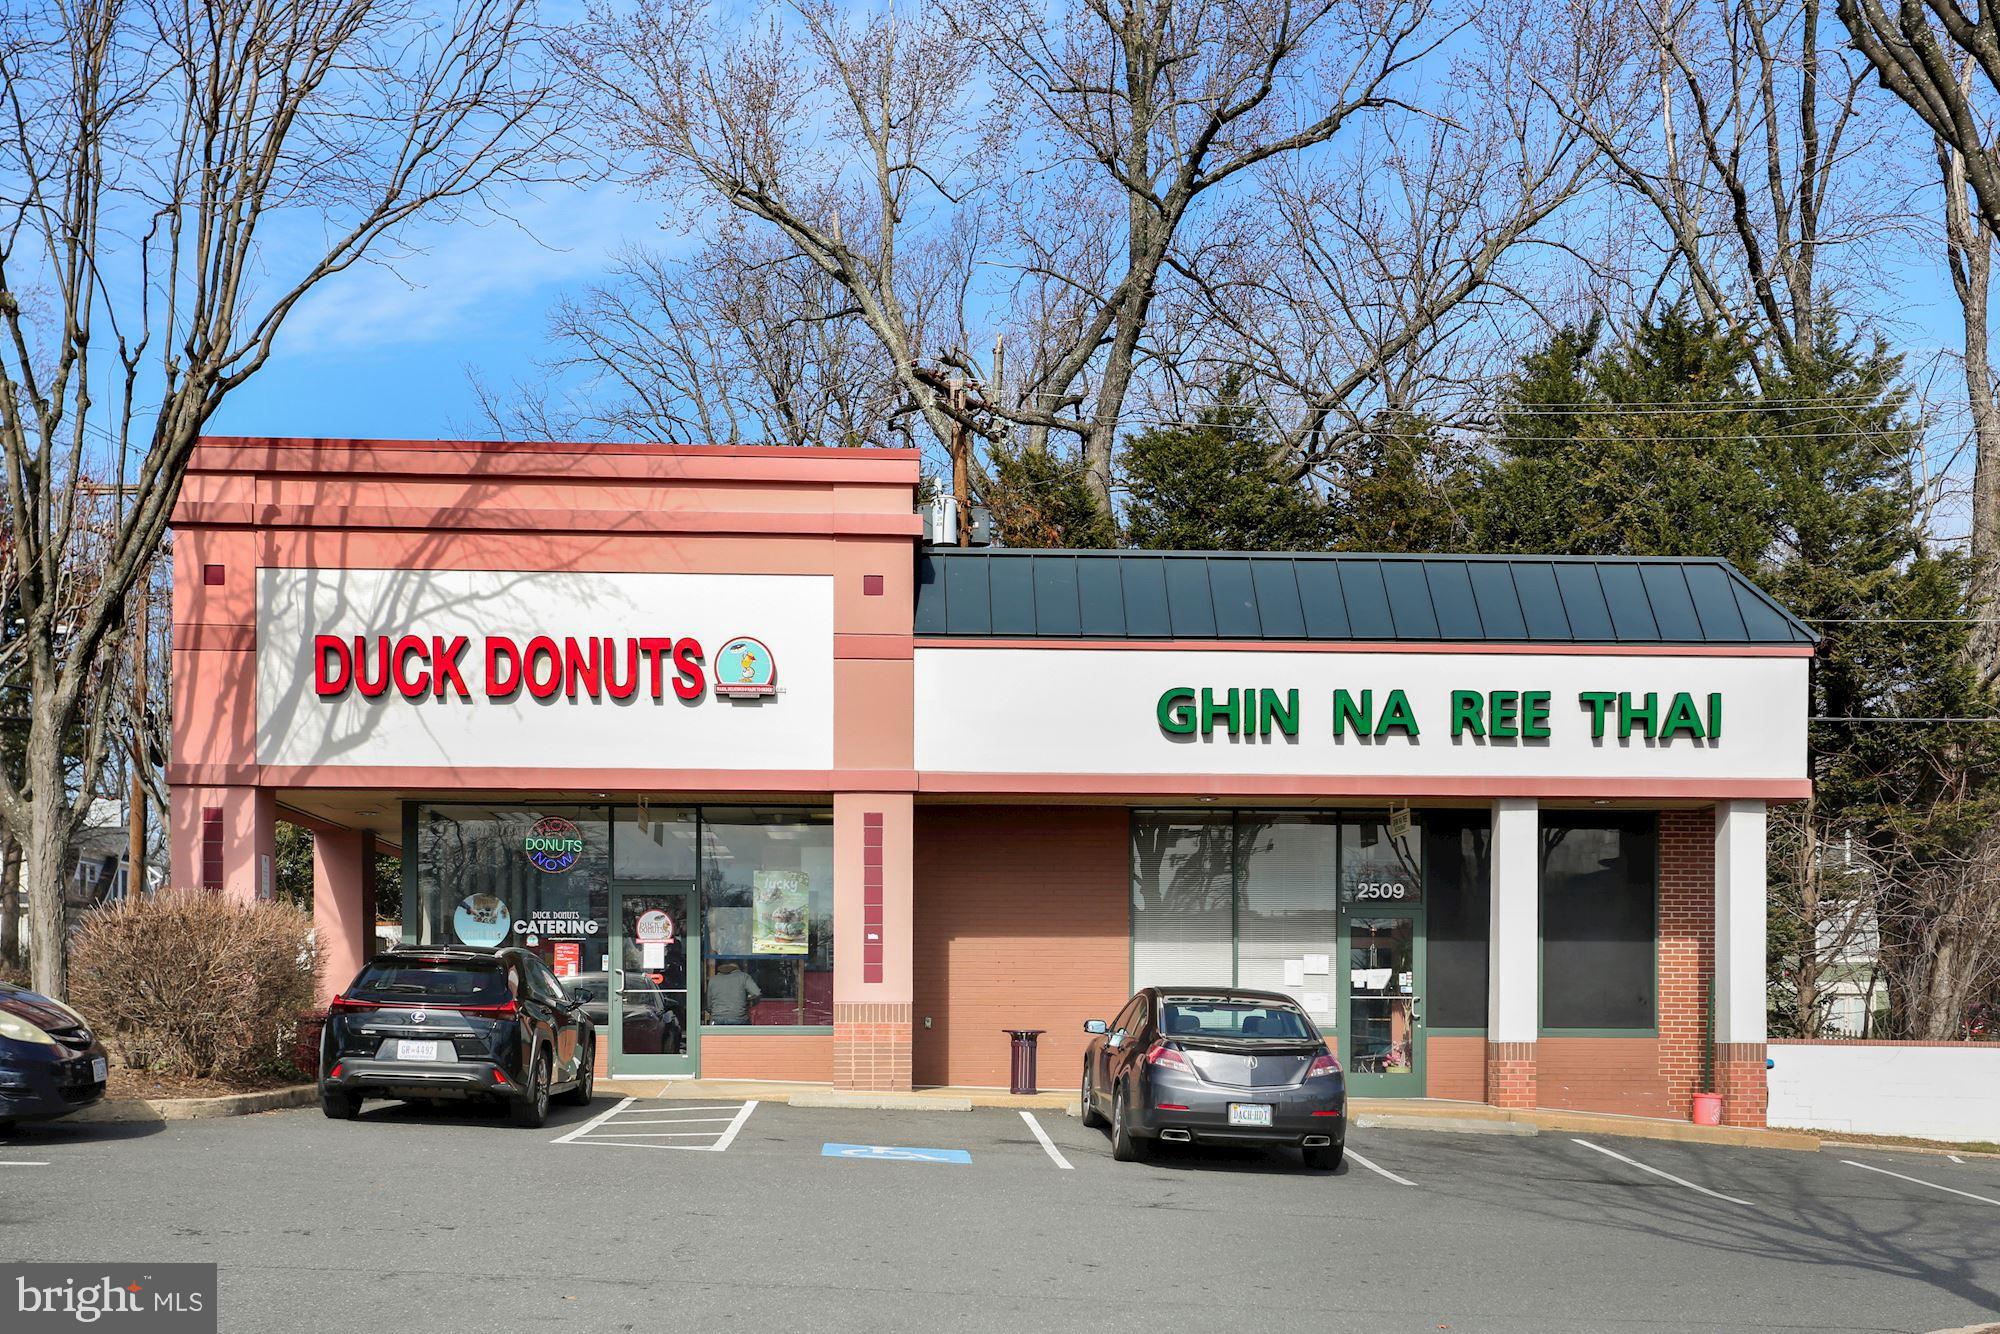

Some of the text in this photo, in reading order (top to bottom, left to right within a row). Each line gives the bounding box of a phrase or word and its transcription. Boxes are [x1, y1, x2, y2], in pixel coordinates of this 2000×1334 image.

[314, 634, 706, 701] DUCK DONUTS
[1156, 687, 1722, 738] GHIN NA REE THAI
[525, 837, 583, 853] DONUTS
[532, 851, 573, 870] NOW
[1357, 882, 1405, 899] 2509
[532, 911, 580, 920] DUCK DONUTS
[513, 919, 599, 935] CATERING
